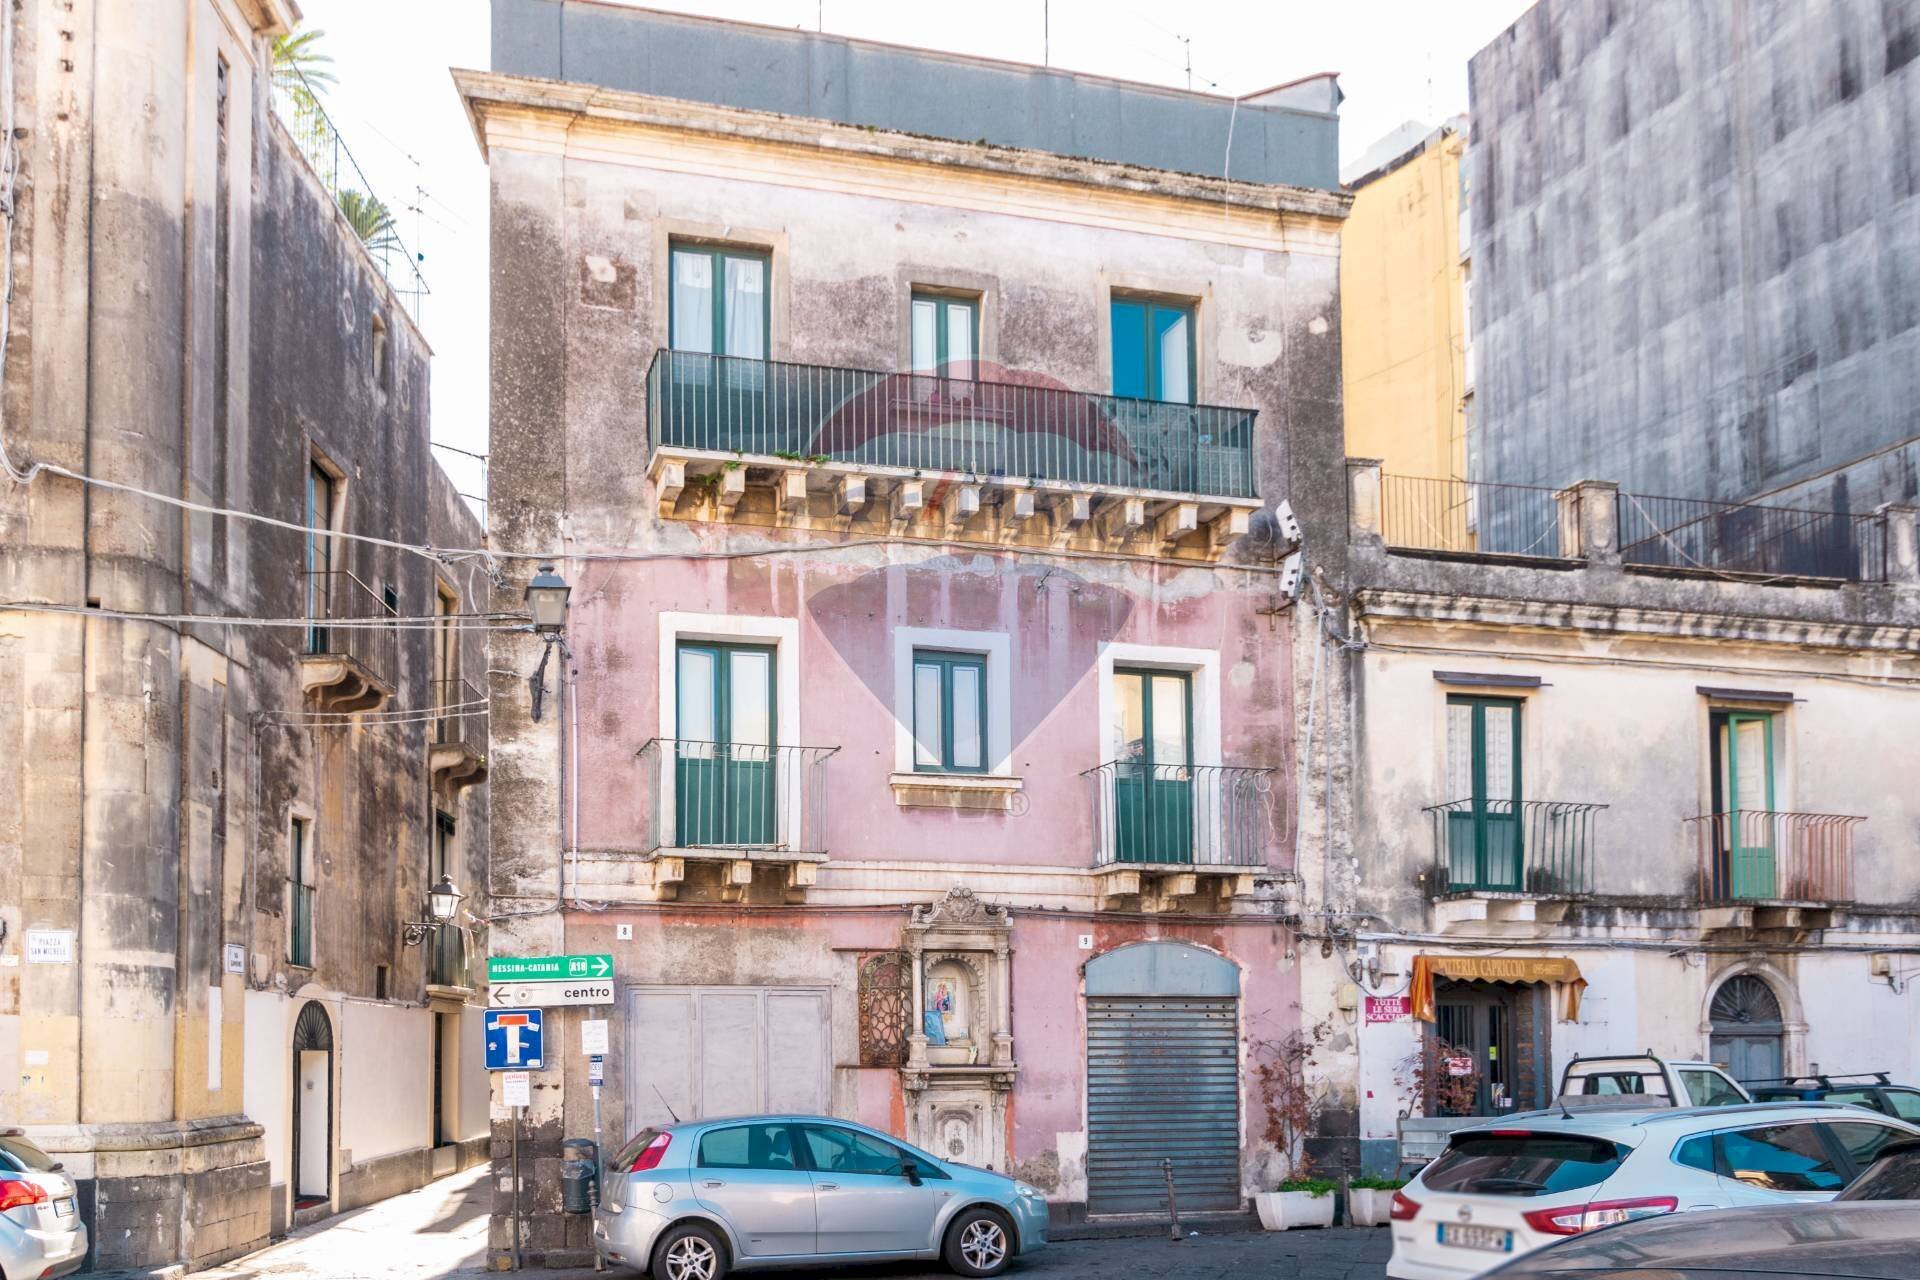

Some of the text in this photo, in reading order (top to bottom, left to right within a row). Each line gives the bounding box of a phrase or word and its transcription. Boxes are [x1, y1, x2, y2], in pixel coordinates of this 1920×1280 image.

[38, 938, 61, 946] PIAZZA
[492, 961, 586, 973] MESSINA-CATANIA A18
[1480, 959, 1526, 977] CAPRICCIO
[564, 986, 610, 998] centro
[1375, 998, 1402, 1006] TUTTE
